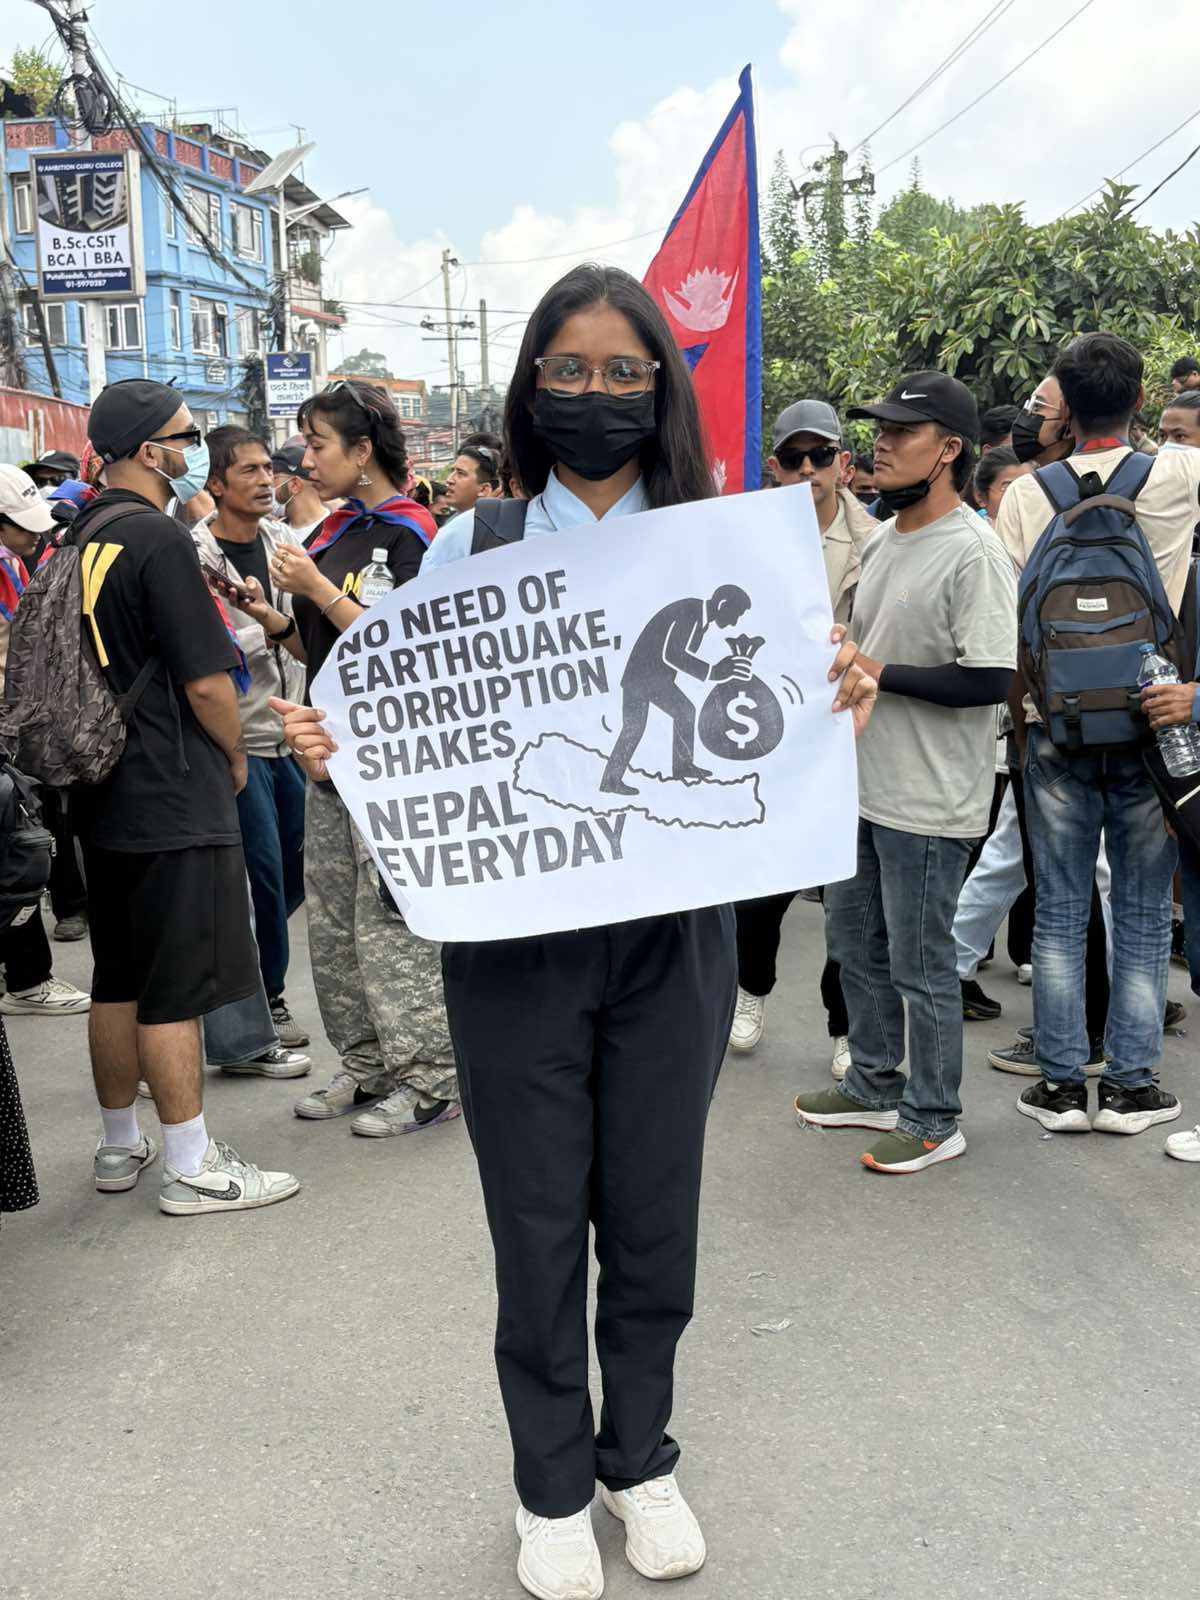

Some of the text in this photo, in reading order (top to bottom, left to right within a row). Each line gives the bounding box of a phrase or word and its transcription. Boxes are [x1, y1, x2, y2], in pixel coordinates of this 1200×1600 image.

[95, 161, 124, 169] COLLEGE
[47, 253, 76, 266] BCA
[94, 251, 124, 264] BBA
[53, 235, 116, 250] B.Sc.CSIT
[337, 569, 567, 662] NO NEED OF
[337, 608, 622, 697] EARTHQUAKE,
[349, 656, 610, 738] CORRUPTION
[356, 720, 516, 781] SHAKES
[366, 780, 528, 842] NEPAL
[376, 813, 627, 888] EVERYDAY
